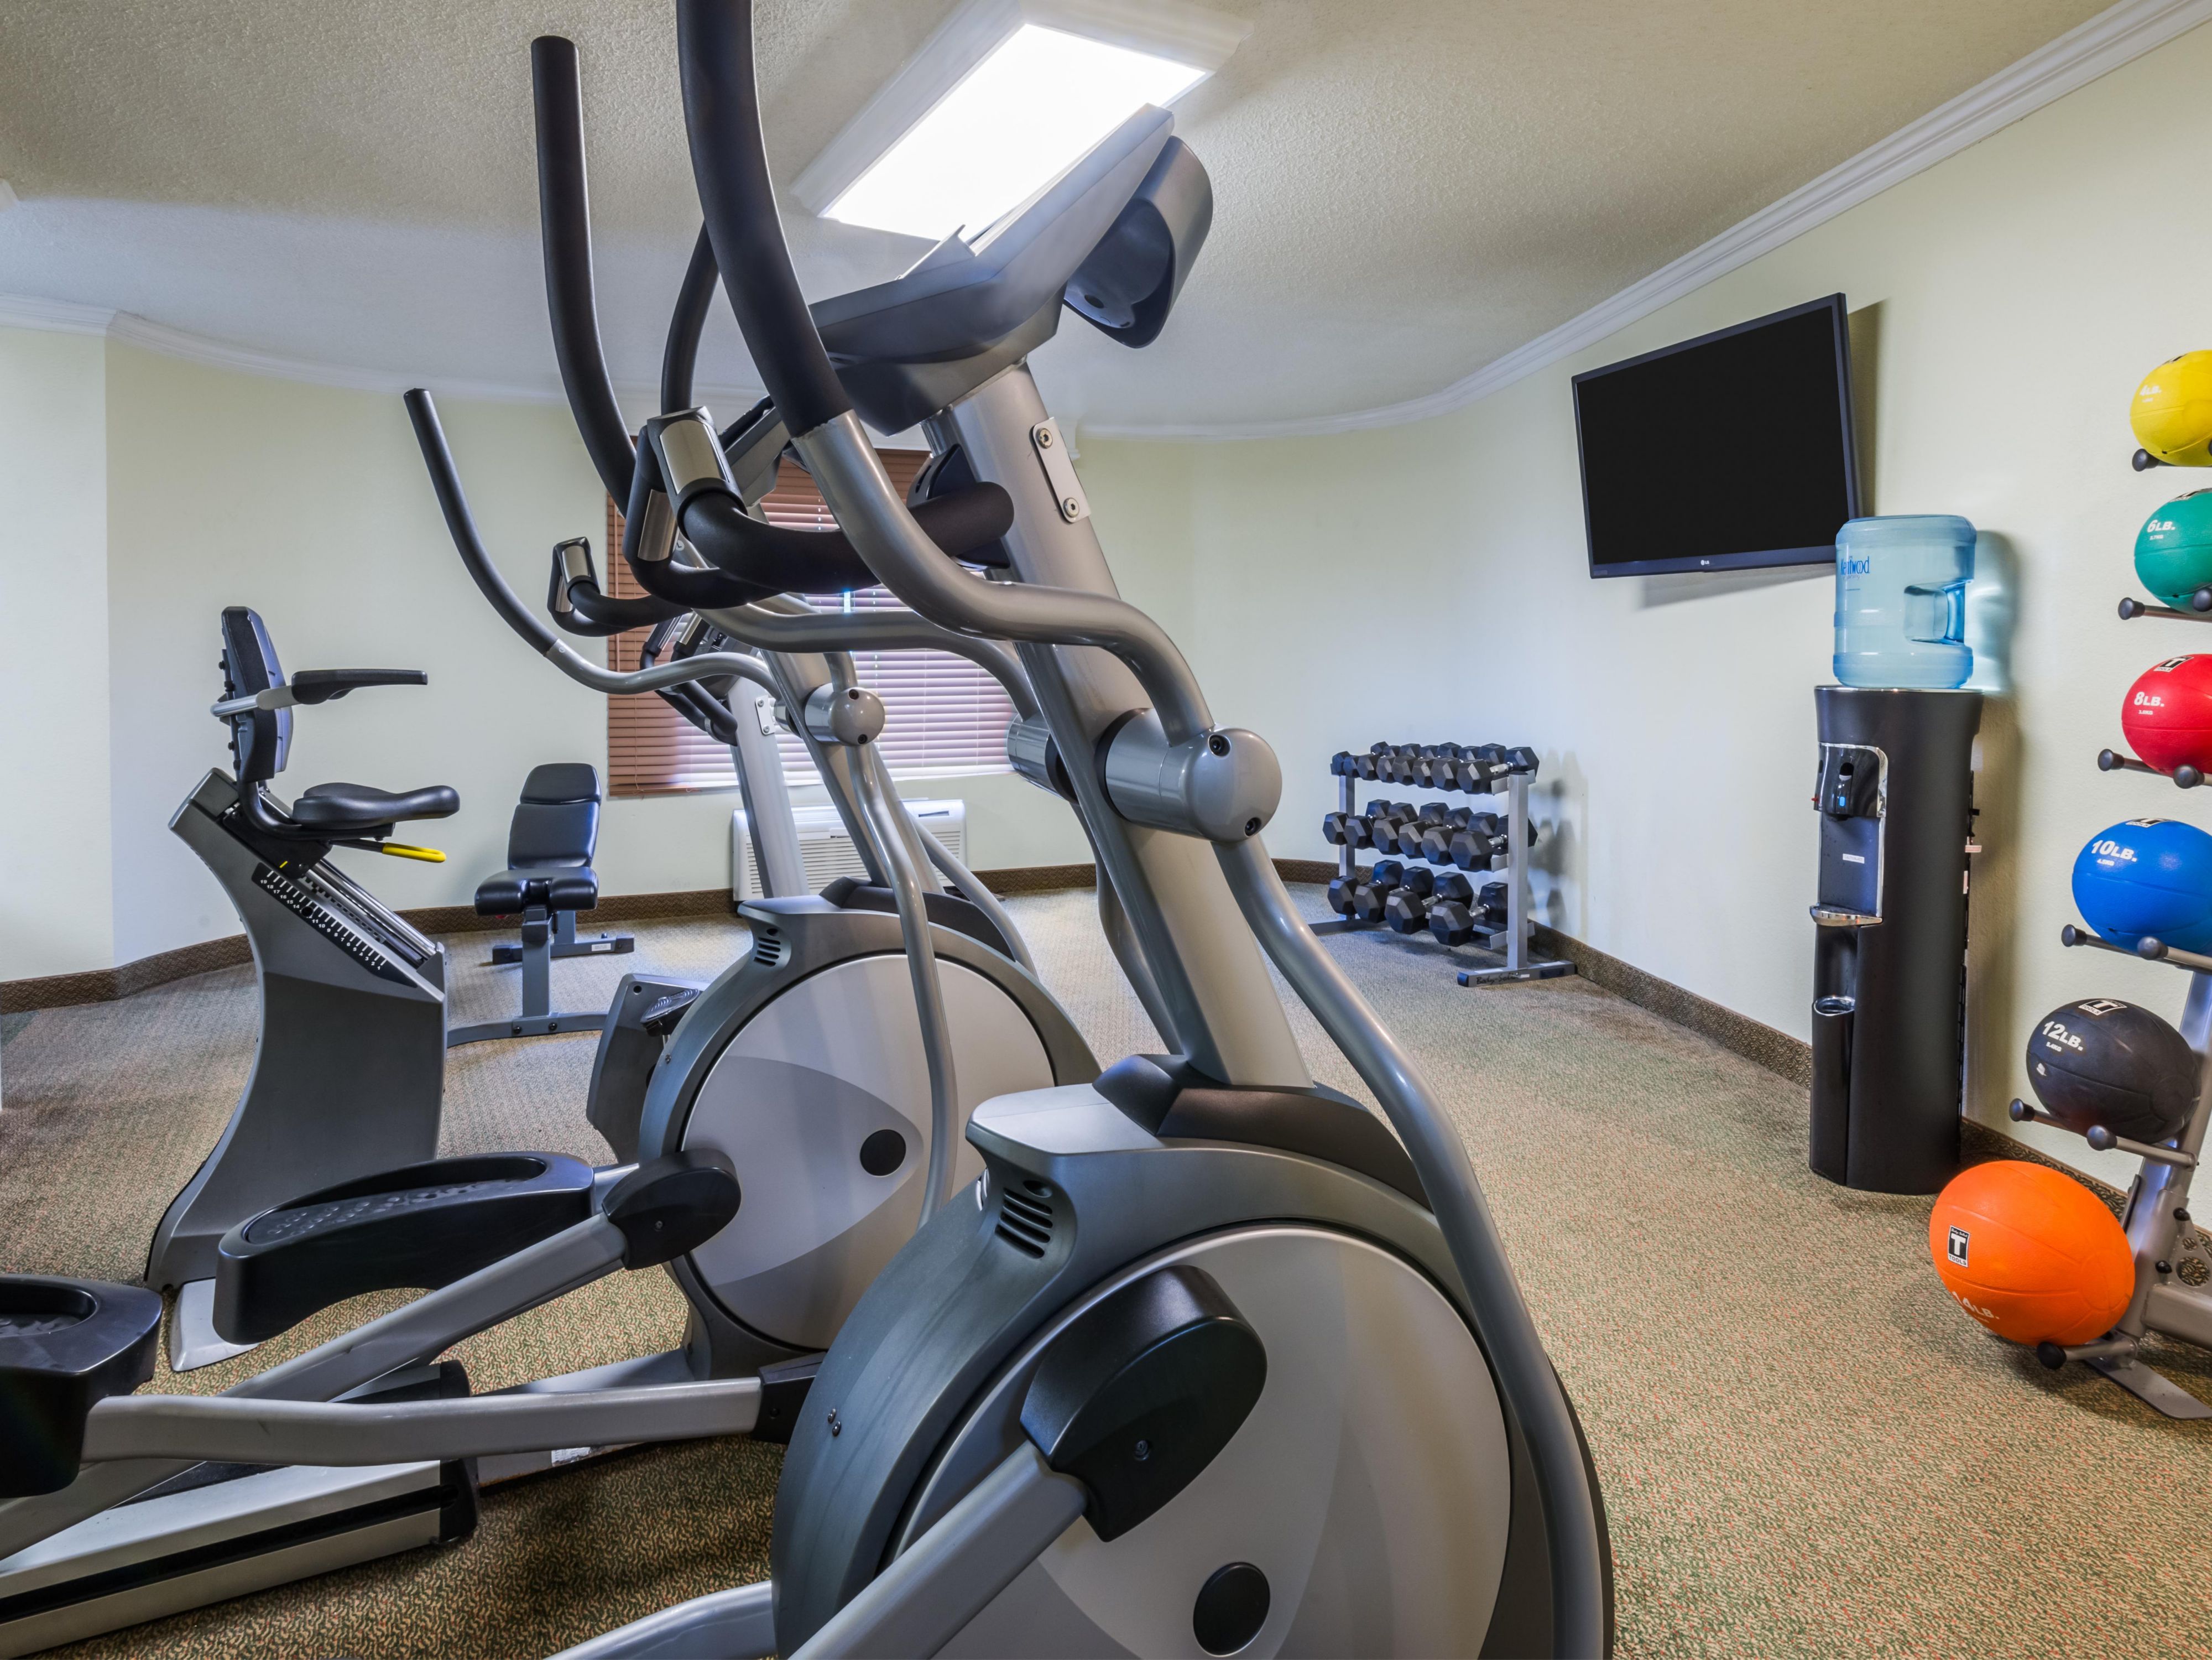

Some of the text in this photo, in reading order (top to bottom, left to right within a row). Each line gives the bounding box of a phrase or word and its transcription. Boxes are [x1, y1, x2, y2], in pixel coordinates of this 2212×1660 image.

[2139, 384, 2162, 396] 4LB.
[2147, 519, 2176, 533] 6LB.
[2133, 691, 2165, 707] 8LB.
[2091, 840, 2138, 862] 10LB.
[2042, 1021, 2084, 1051] 12LB.
[1950, 1232, 1967, 1256] T
[1948, 1254, 1966, 1266] TOOLS
[1952, 1290, 2000, 1320] 14LB.
